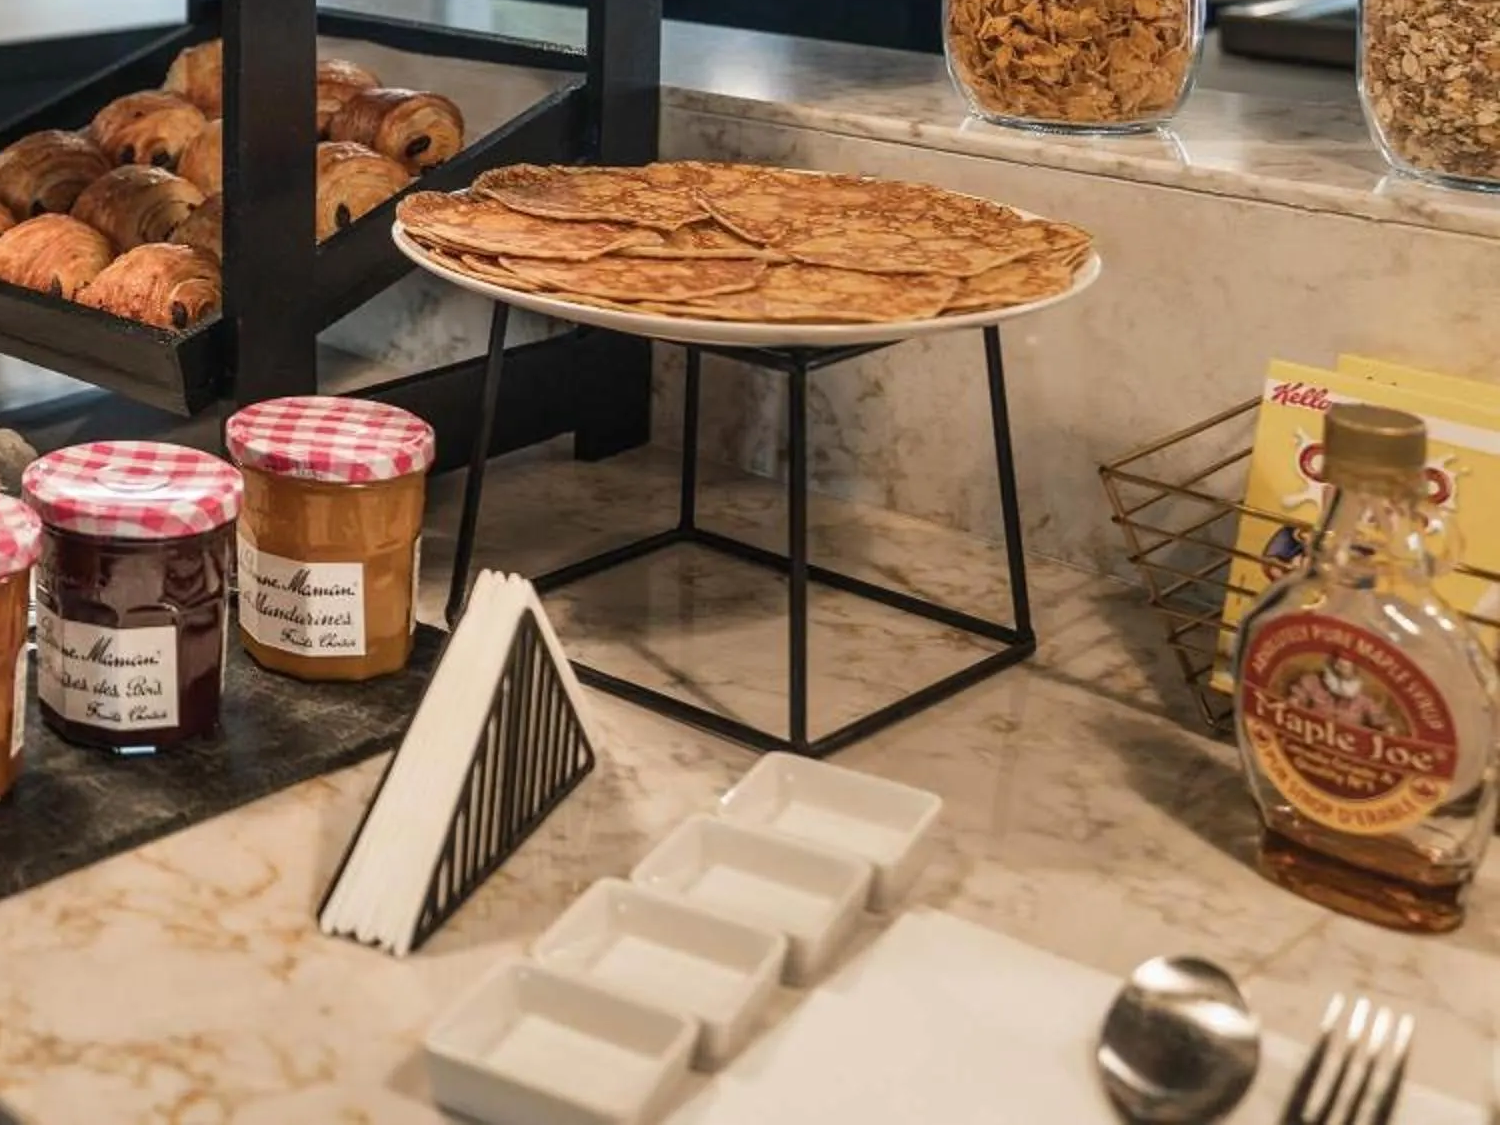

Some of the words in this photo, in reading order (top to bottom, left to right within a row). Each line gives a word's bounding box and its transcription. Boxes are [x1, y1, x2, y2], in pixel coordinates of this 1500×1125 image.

[1271, 382, 1332, 411] Kello
[282, 567, 357, 598] Maman
[81, 634, 160, 668] Maman
[1356, 638, 1411, 684] MAPLE
[1405, 683, 1445, 731] SYRUP
[1253, 689, 1357, 752] Maple
[1370, 734, 1436, 772] Joe
